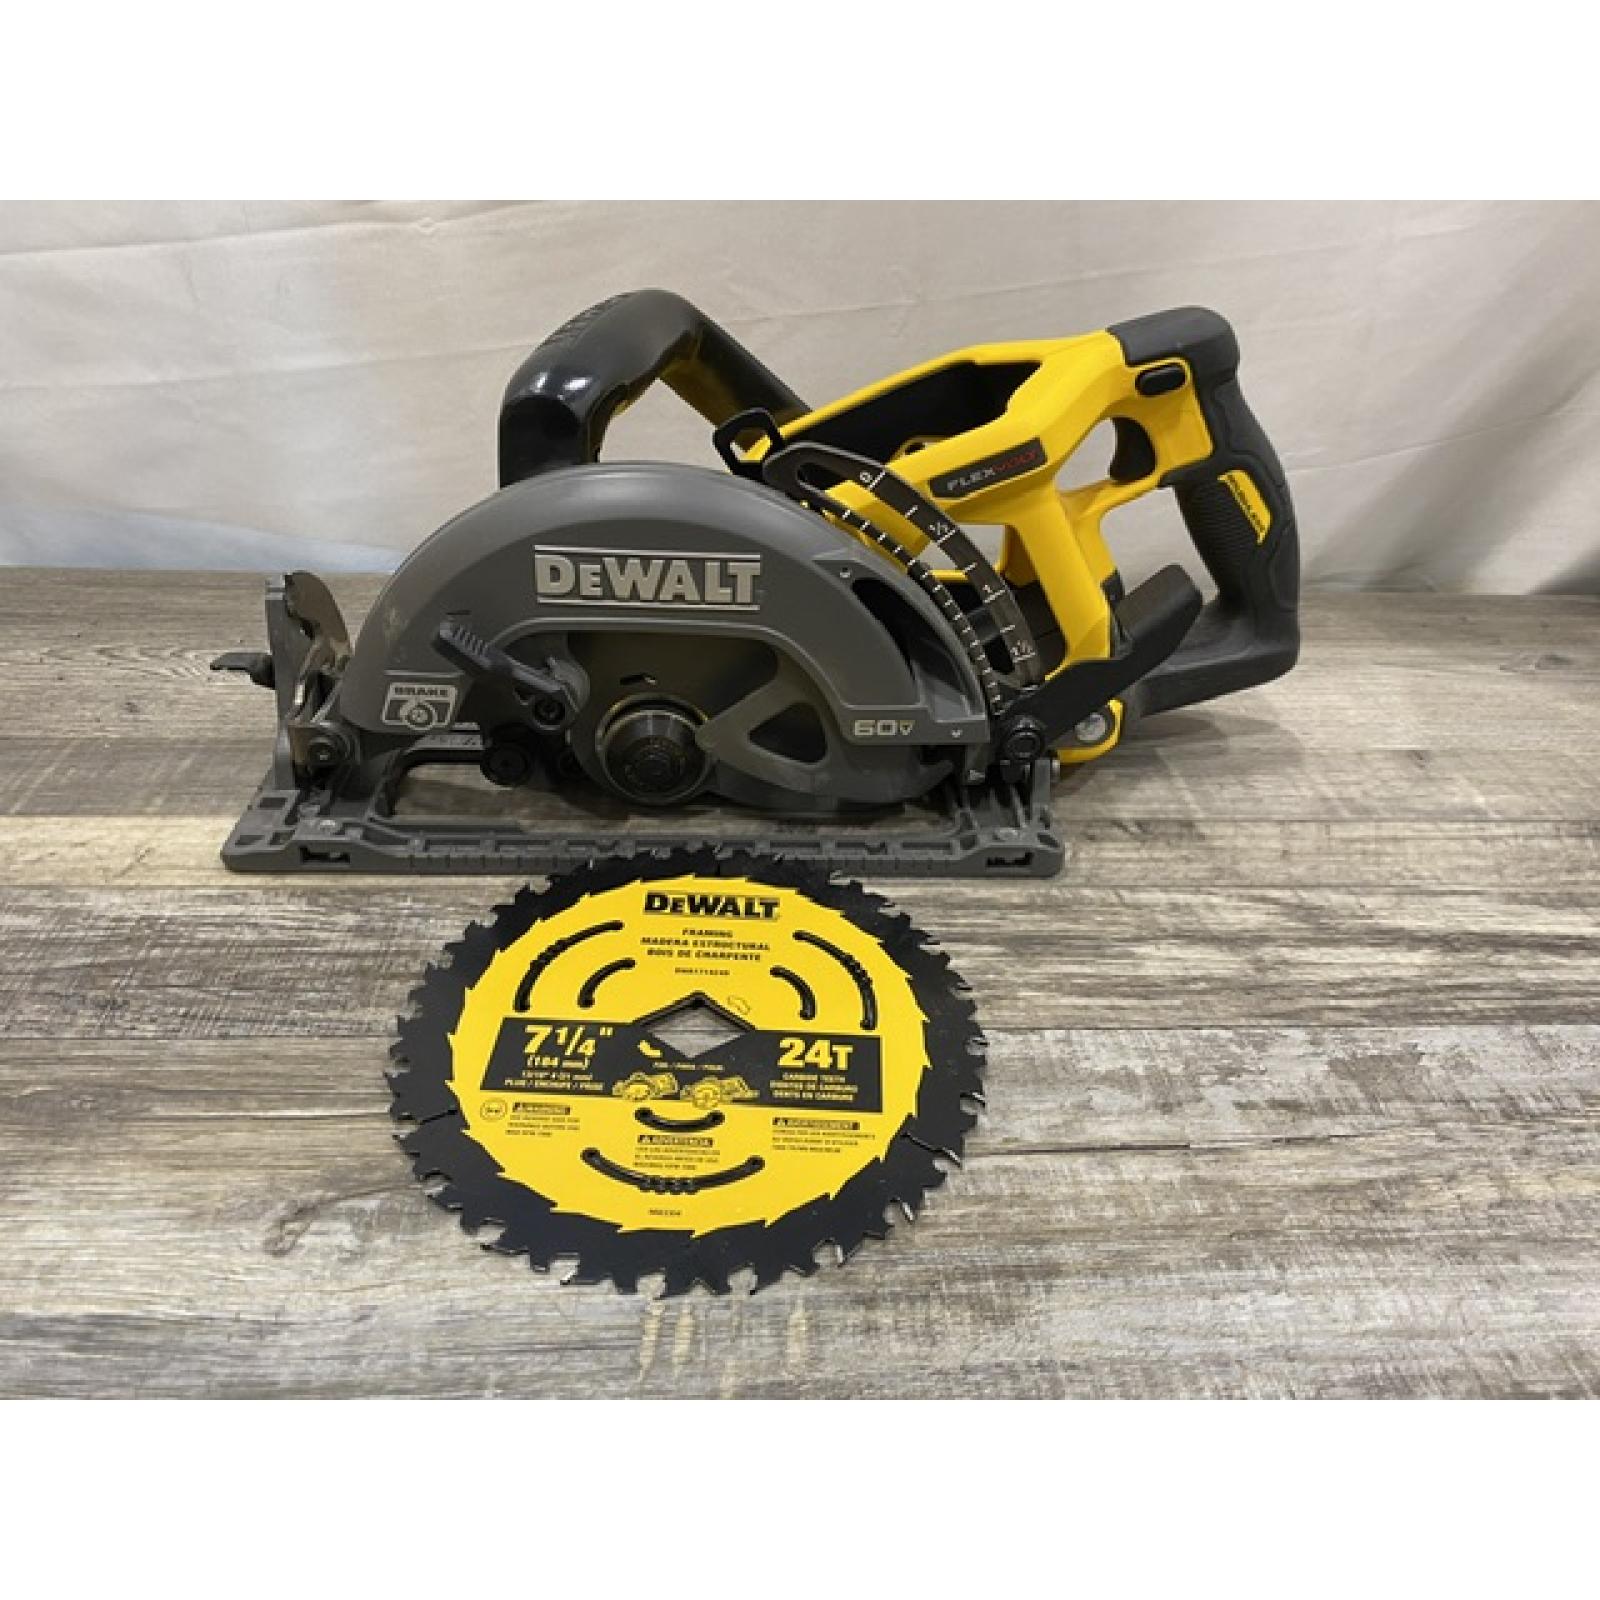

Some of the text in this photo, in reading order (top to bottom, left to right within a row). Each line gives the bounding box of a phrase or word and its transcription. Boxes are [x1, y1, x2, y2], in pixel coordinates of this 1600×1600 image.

[394, 686, 450, 696] BRAKE
[682, 928, 733, 938] FRAMING
[640, 936, 770, 951] MADERA ESTRUCTURAL
[777, 1036, 854, 1071] 24T
